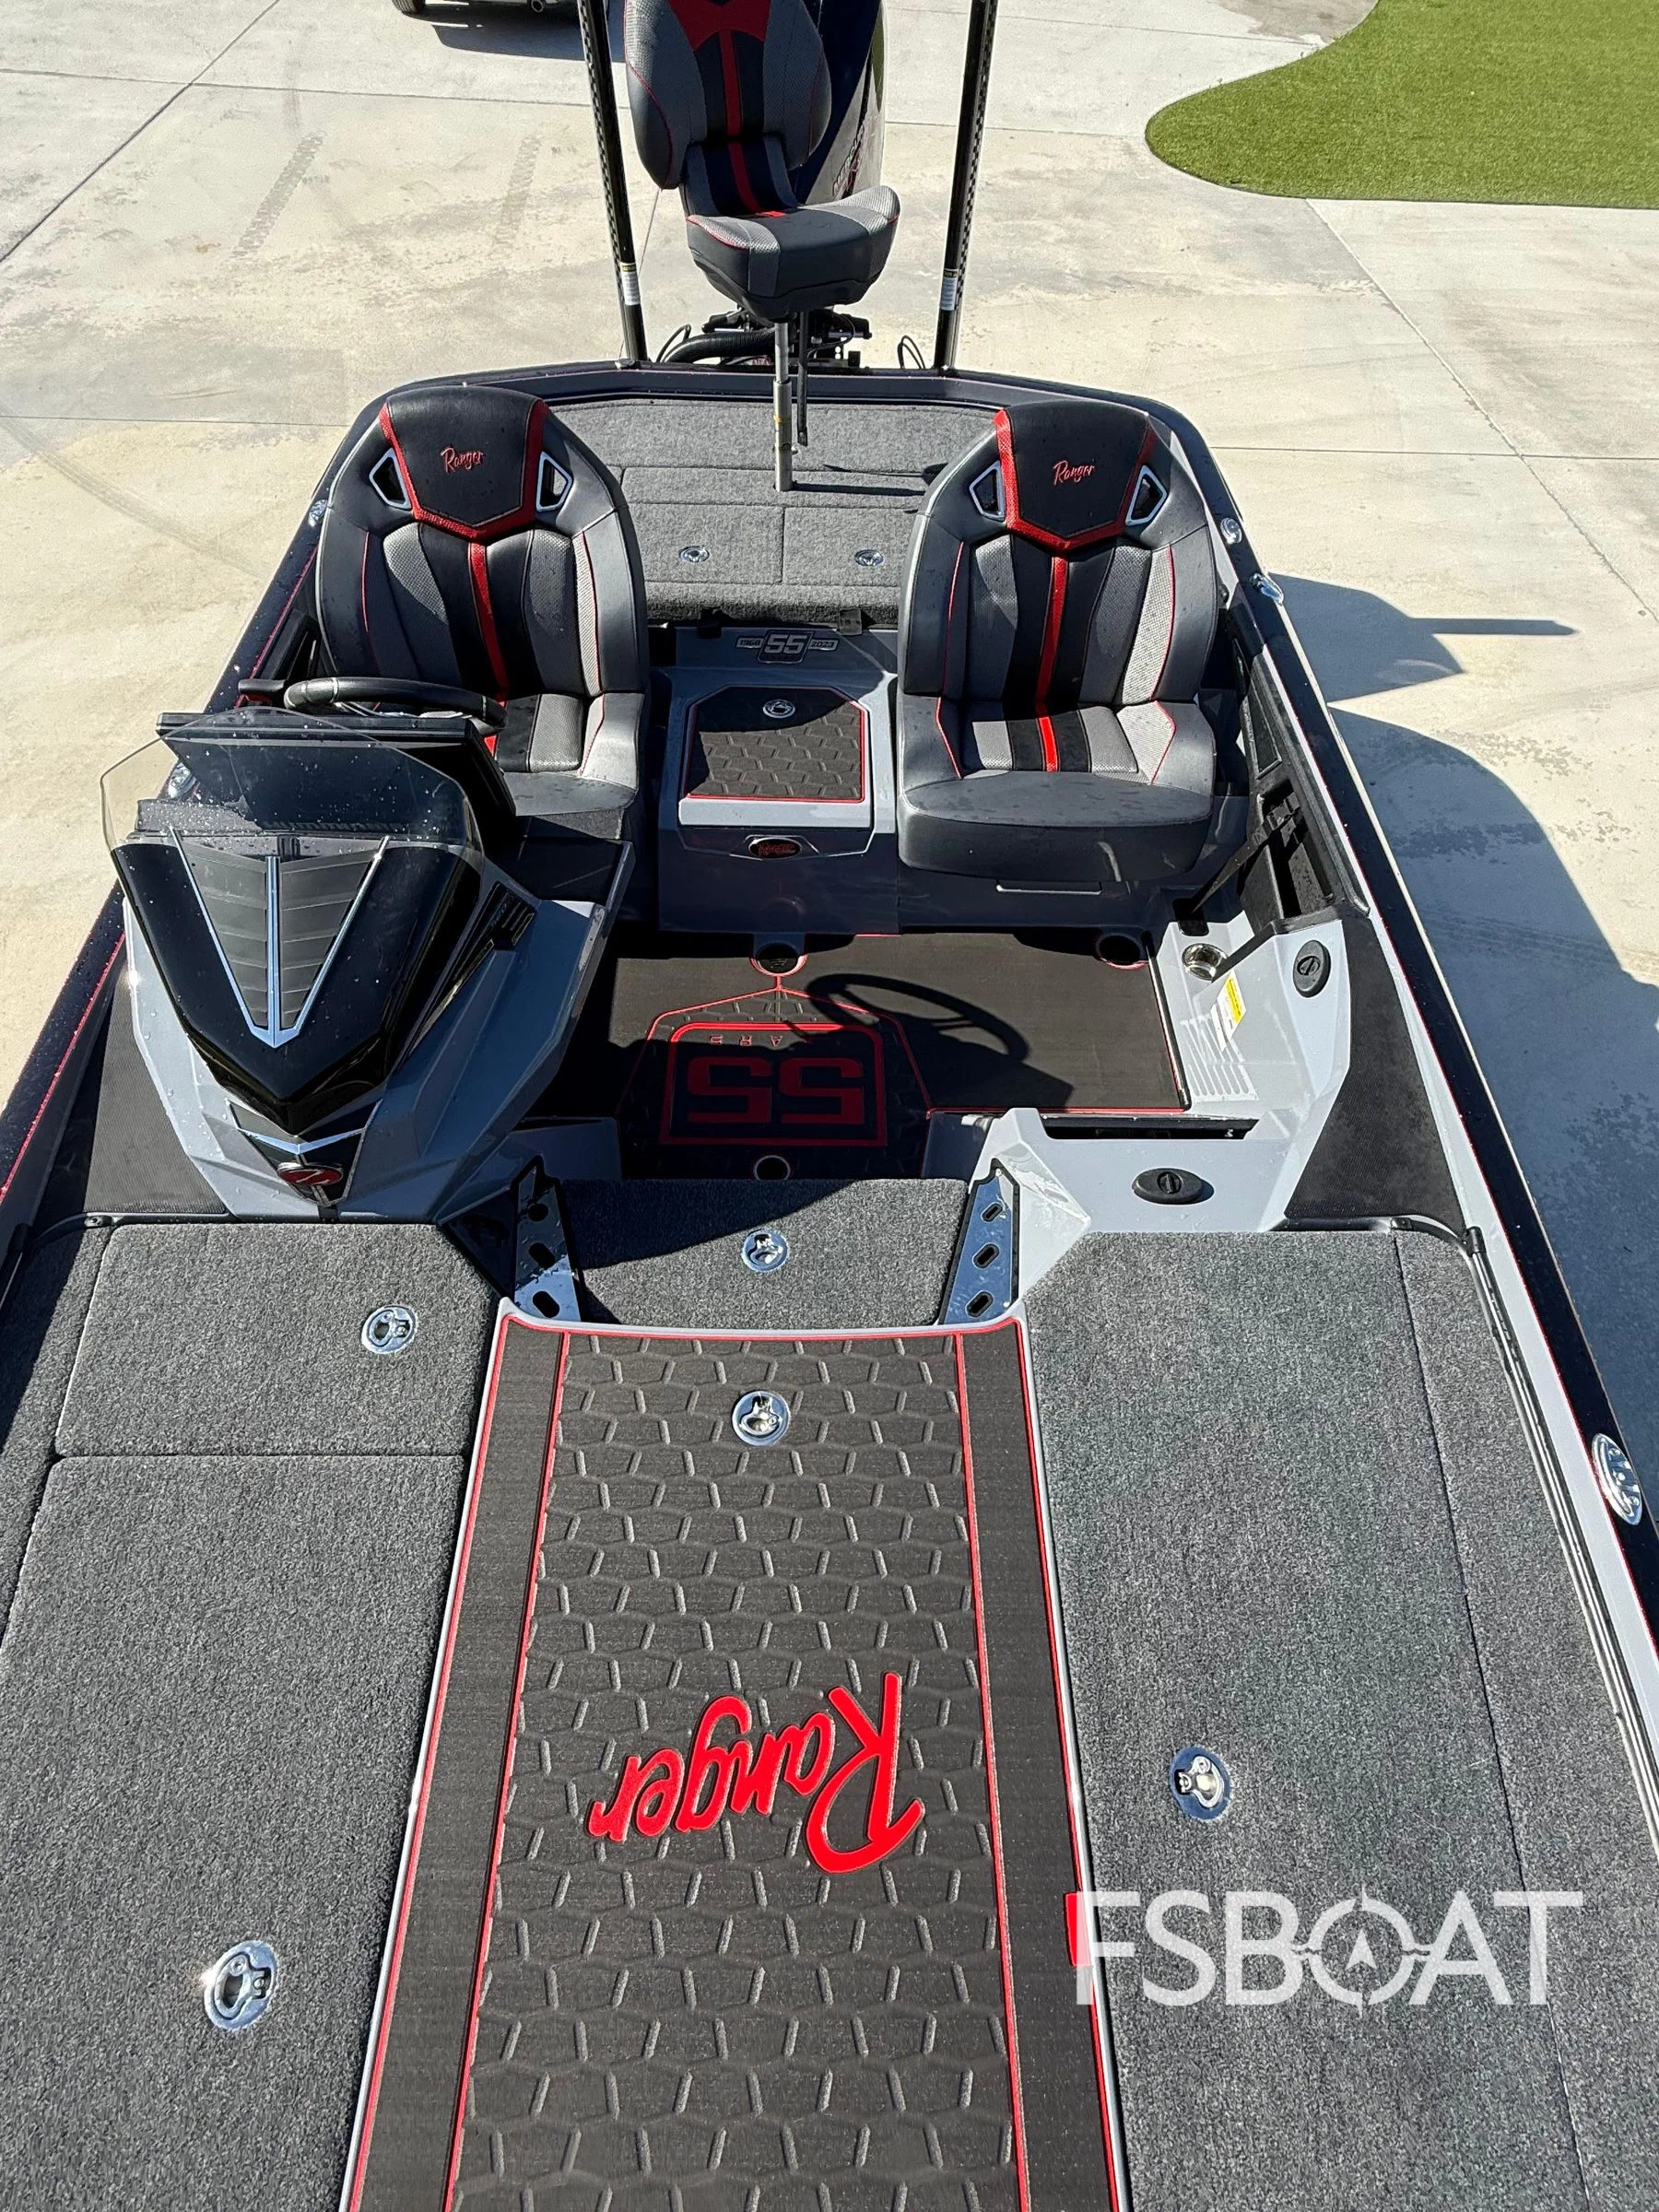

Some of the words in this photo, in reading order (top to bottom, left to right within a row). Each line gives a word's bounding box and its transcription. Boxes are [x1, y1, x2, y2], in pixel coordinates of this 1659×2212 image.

[440, 446, 484, 473] Ranger
[1053, 460, 1095, 487] Ranger
[764, 634, 807, 654] 55
[688, 1056, 865, 1124] 55
[584, 1672, 925, 1875] Ranger
